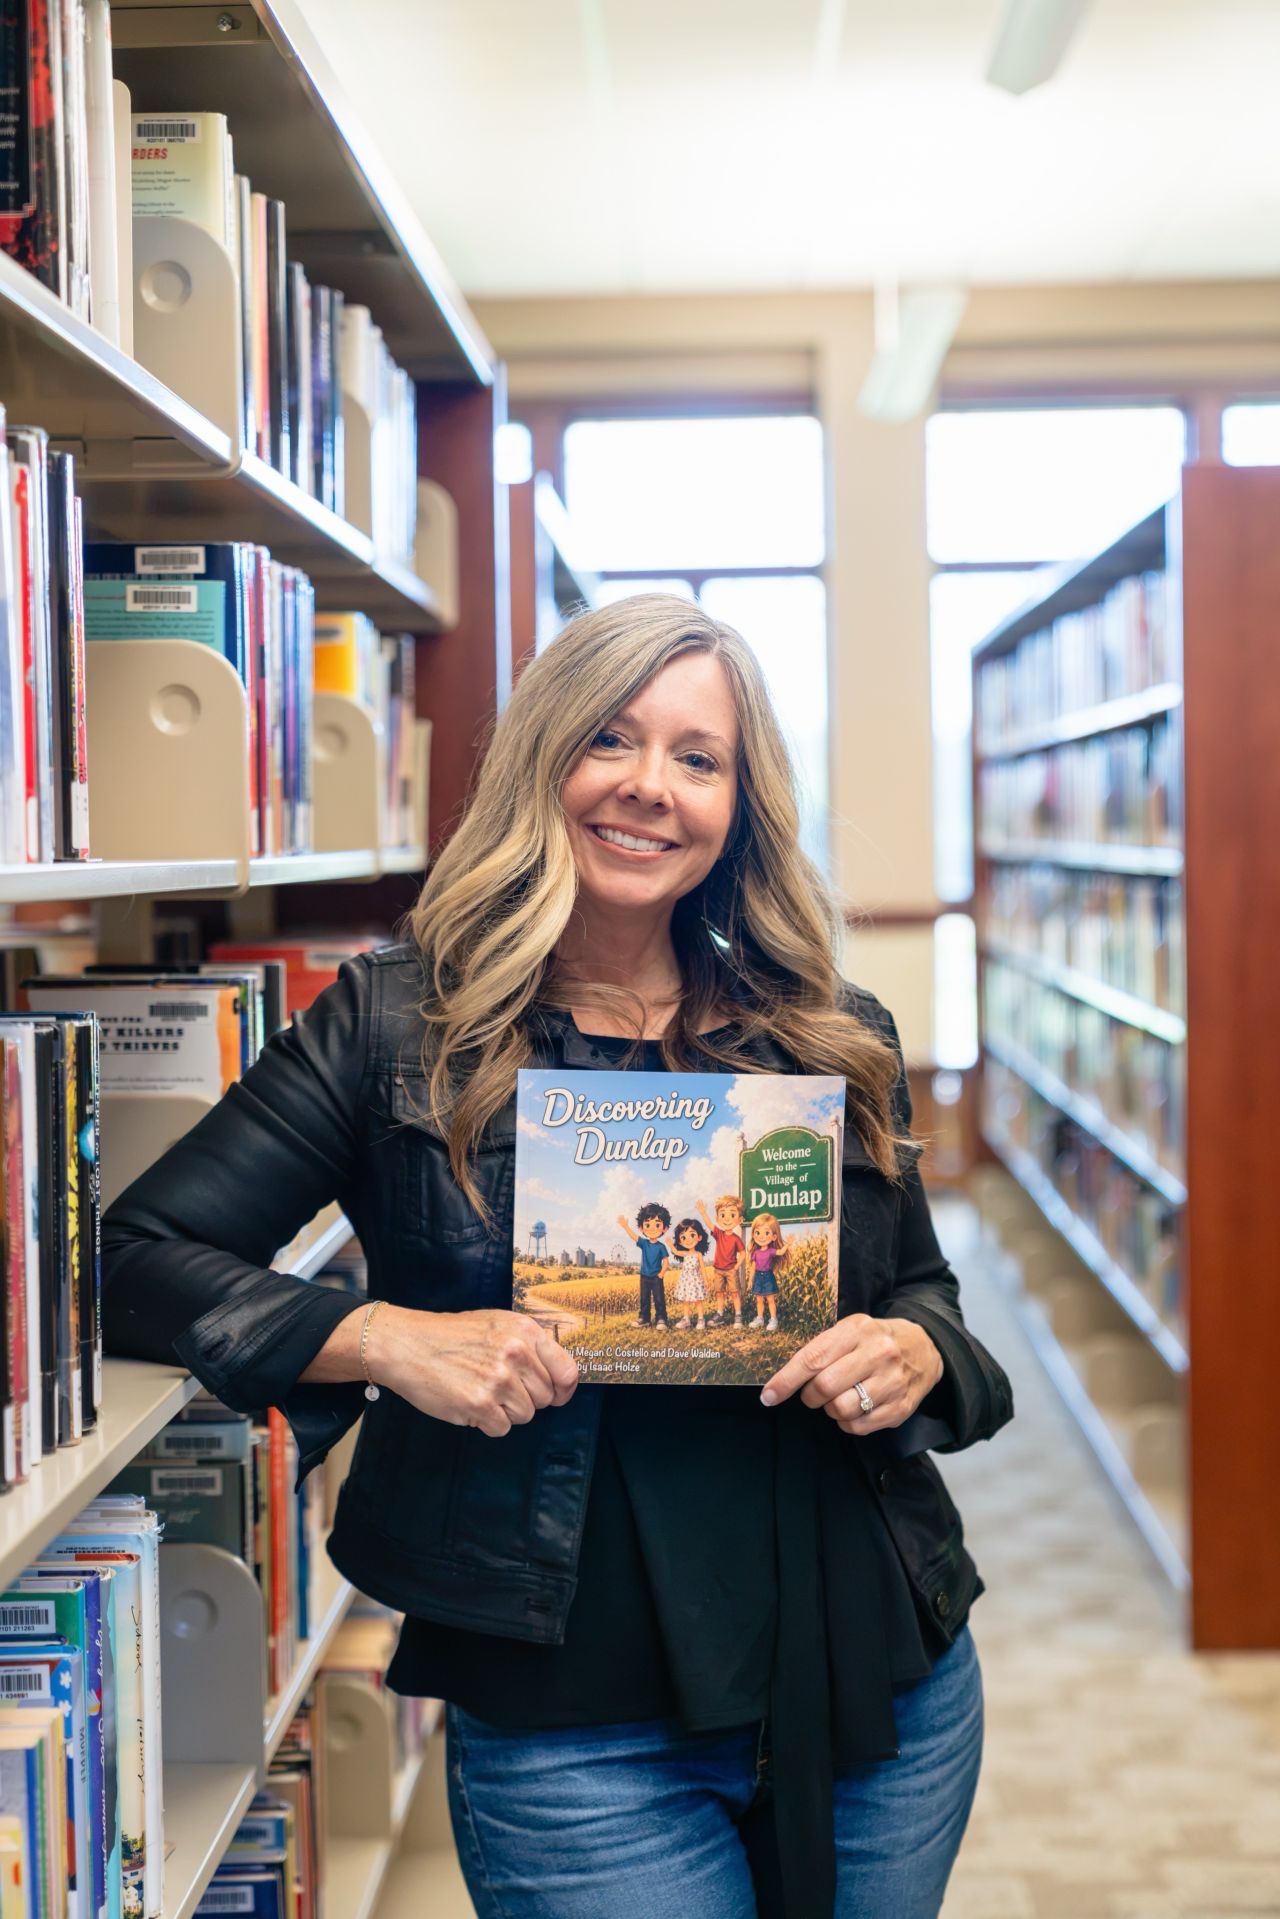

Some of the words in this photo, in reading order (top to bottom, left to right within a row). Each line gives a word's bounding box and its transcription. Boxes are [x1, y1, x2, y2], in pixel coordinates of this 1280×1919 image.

[117, 1028, 184, 1037] KILLERS
[113, 1042, 179, 1051] THIEVES
[542, 1087, 715, 1130] Discovering
[574, 1127, 688, 1170] Dunlap
[761, 1147, 812, 1162] Welcome
[775, 1164, 784, 1172] to
[785, 1162, 797, 1171] the
[764, 1174, 795, 1186] Village
[799, 1172, 809, 1183] of
[749, 1184, 823, 1211] Dunlap
[576, 1346, 604, 1360] Megan
[606, 1346, 613, 1357] C
[614, 1347, 649, 1358] Costello
[651, 1347, 666, 1358] and
[667, 1348, 689, 1358] Dave
[690, 1348, 721, 1359] Walden
[577, 1360, 588, 1374] by
[589, 1361, 613, 1372] Isaac
[615, 1361, 640, 1372] Holze
